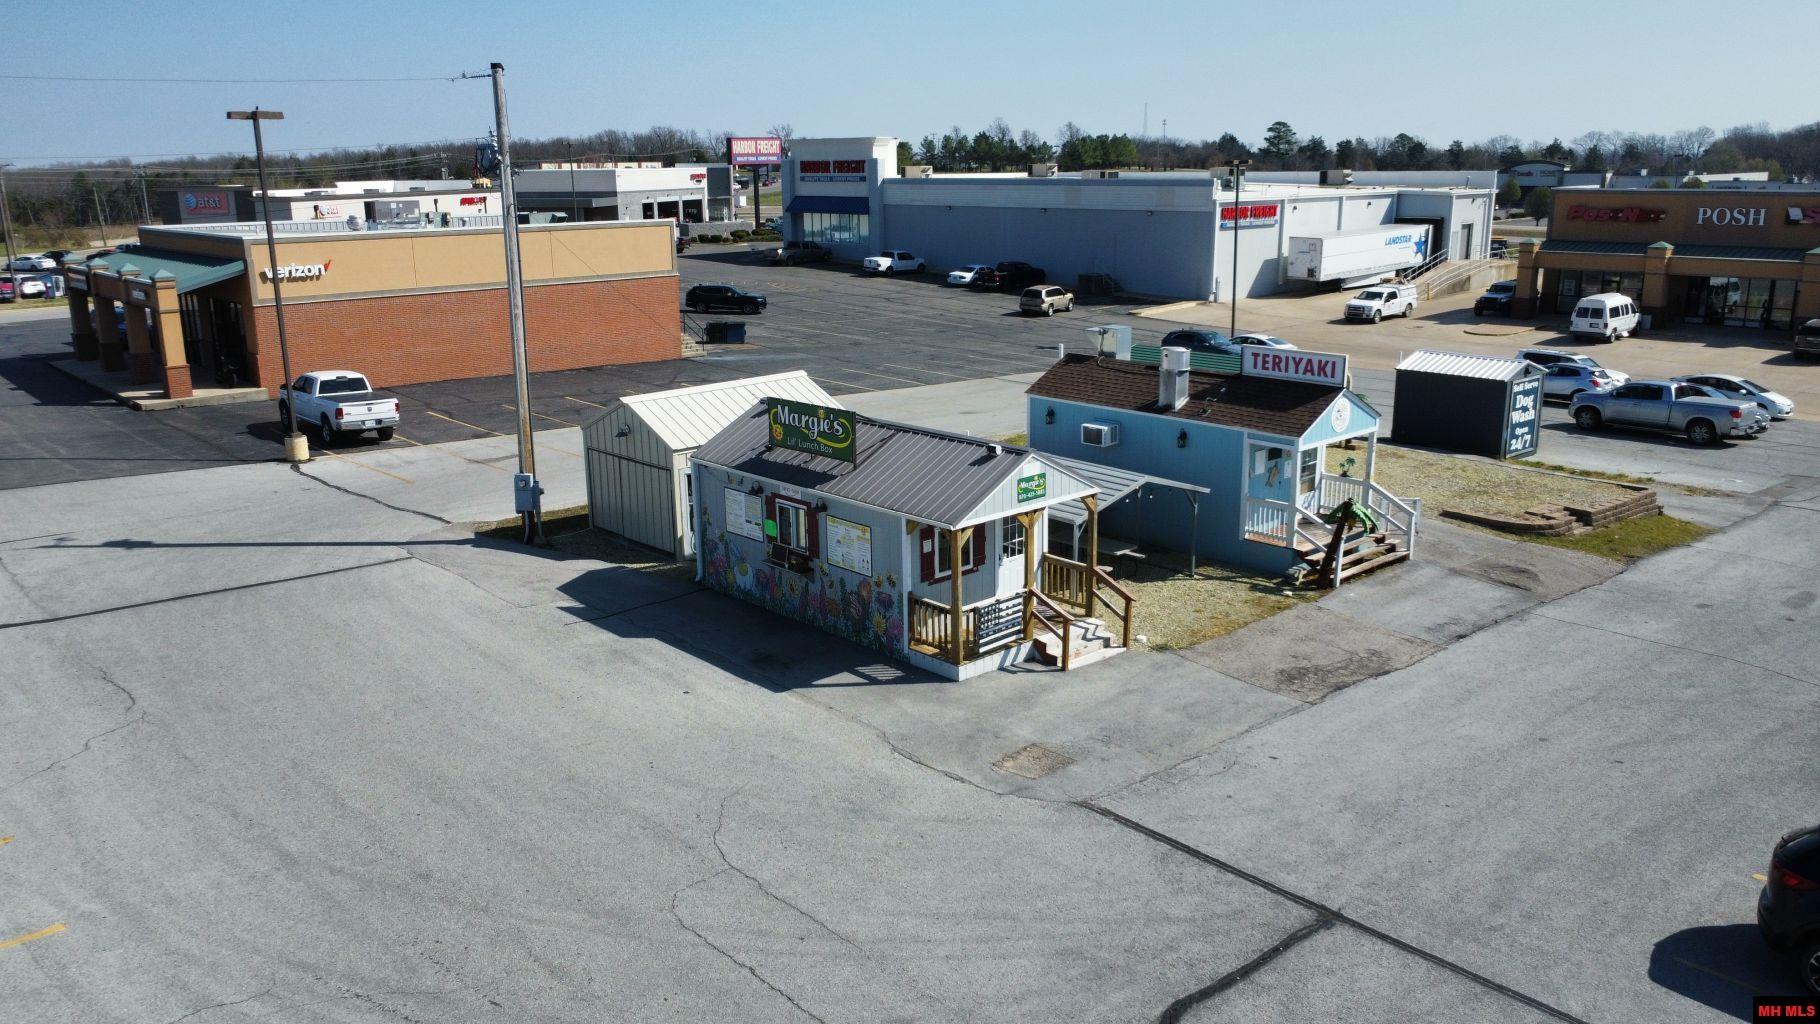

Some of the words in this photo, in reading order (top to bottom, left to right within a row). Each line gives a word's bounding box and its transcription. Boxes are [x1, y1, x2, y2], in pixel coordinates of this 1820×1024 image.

[732, 140, 756, 154] HARBOR
[756, 140, 780, 154] FREIGHT
[198, 195, 221, 208] at&t
[1696, 207, 1768, 226] POSH
[1384, 234, 1412, 246] LANDSTAR
[264, 262, 326, 279] verizon
[1251, 352, 1337, 379] TERIYAKI
[1513, 382, 1524, 393] Self
[1524, 380, 1539, 390] Serve
[1515, 394, 1535, 409] Dog
[777, 404, 843, 440] Margie's
[1511, 408, 1535, 424] Wash
[1515, 426, 1529, 436] Open
[798, 439, 819, 451] Lunch
[820, 444, 833, 454] Box
[1510, 434, 1532, 450] 24/7
